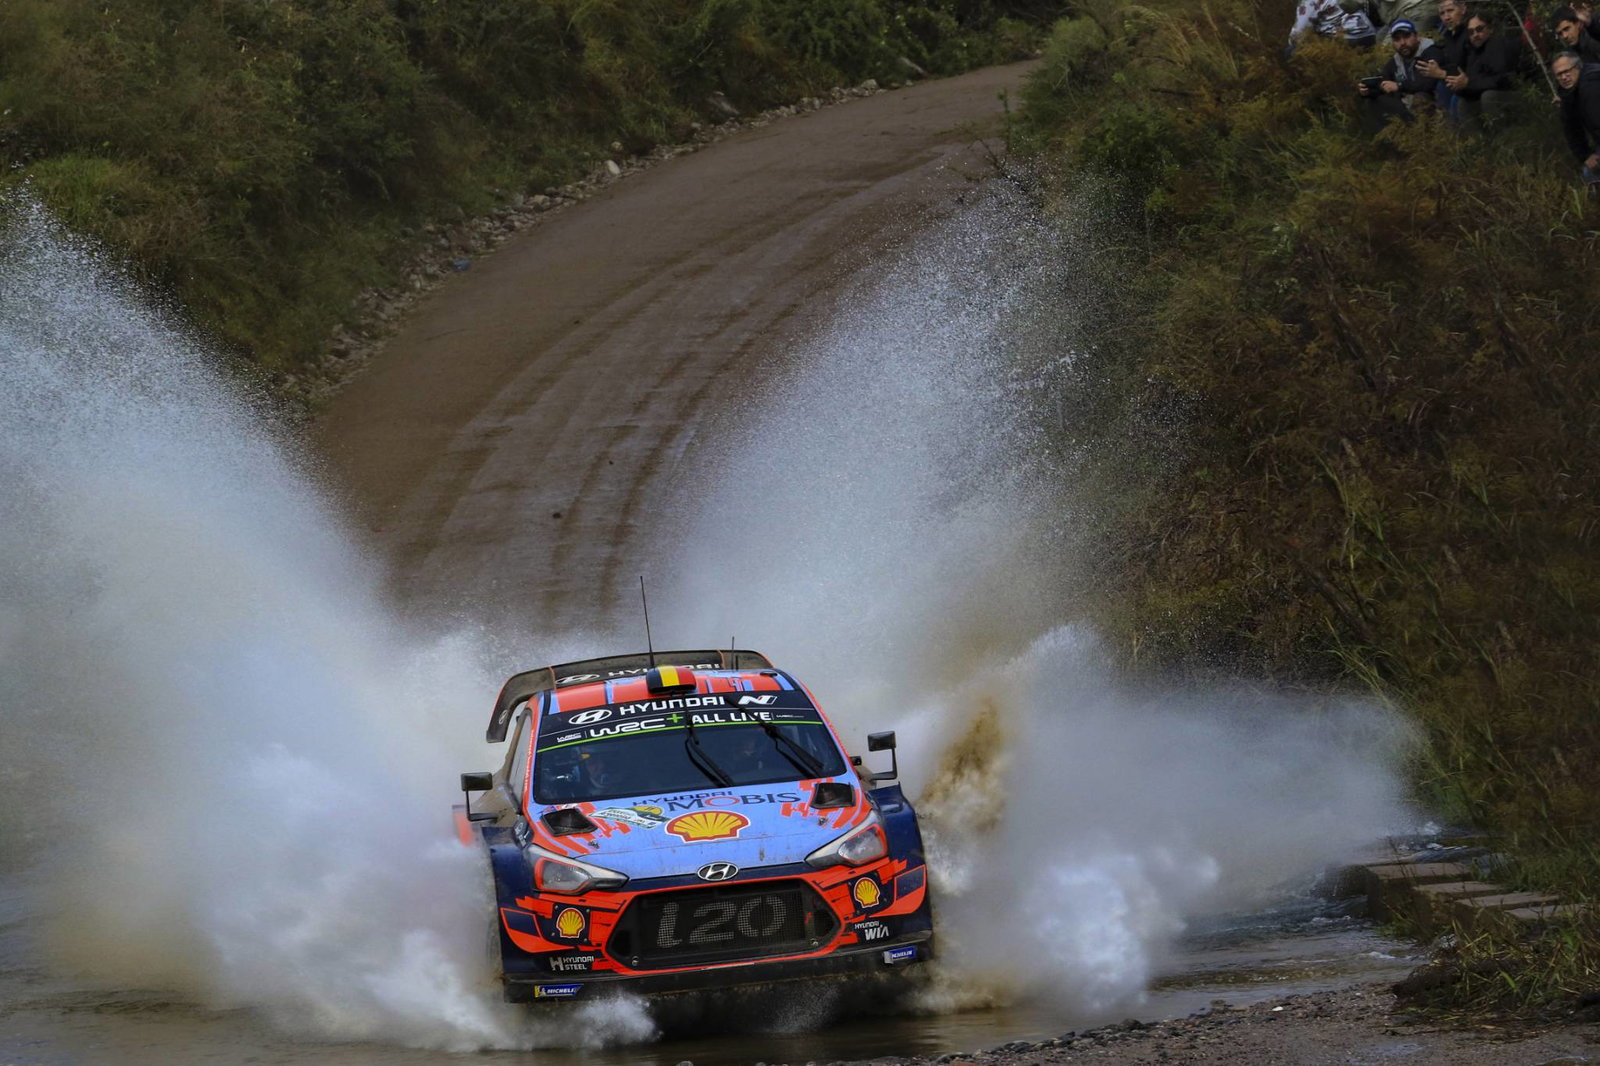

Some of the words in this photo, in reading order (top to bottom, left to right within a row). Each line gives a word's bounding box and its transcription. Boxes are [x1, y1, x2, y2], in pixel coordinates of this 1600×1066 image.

[608, 663, 720, 677] HYAI
[620, 696, 725, 715] HYUNDAI
[692, 711, 726, 724] ALL
[632, 791, 733, 806] HYUNDAI
[668, 792, 801, 812] MOBIS
[854, 920, 880, 930] HYUNDAI
[563, 955, 594, 964] HYUNDAI
[565, 963, 587, 971] STEEL
